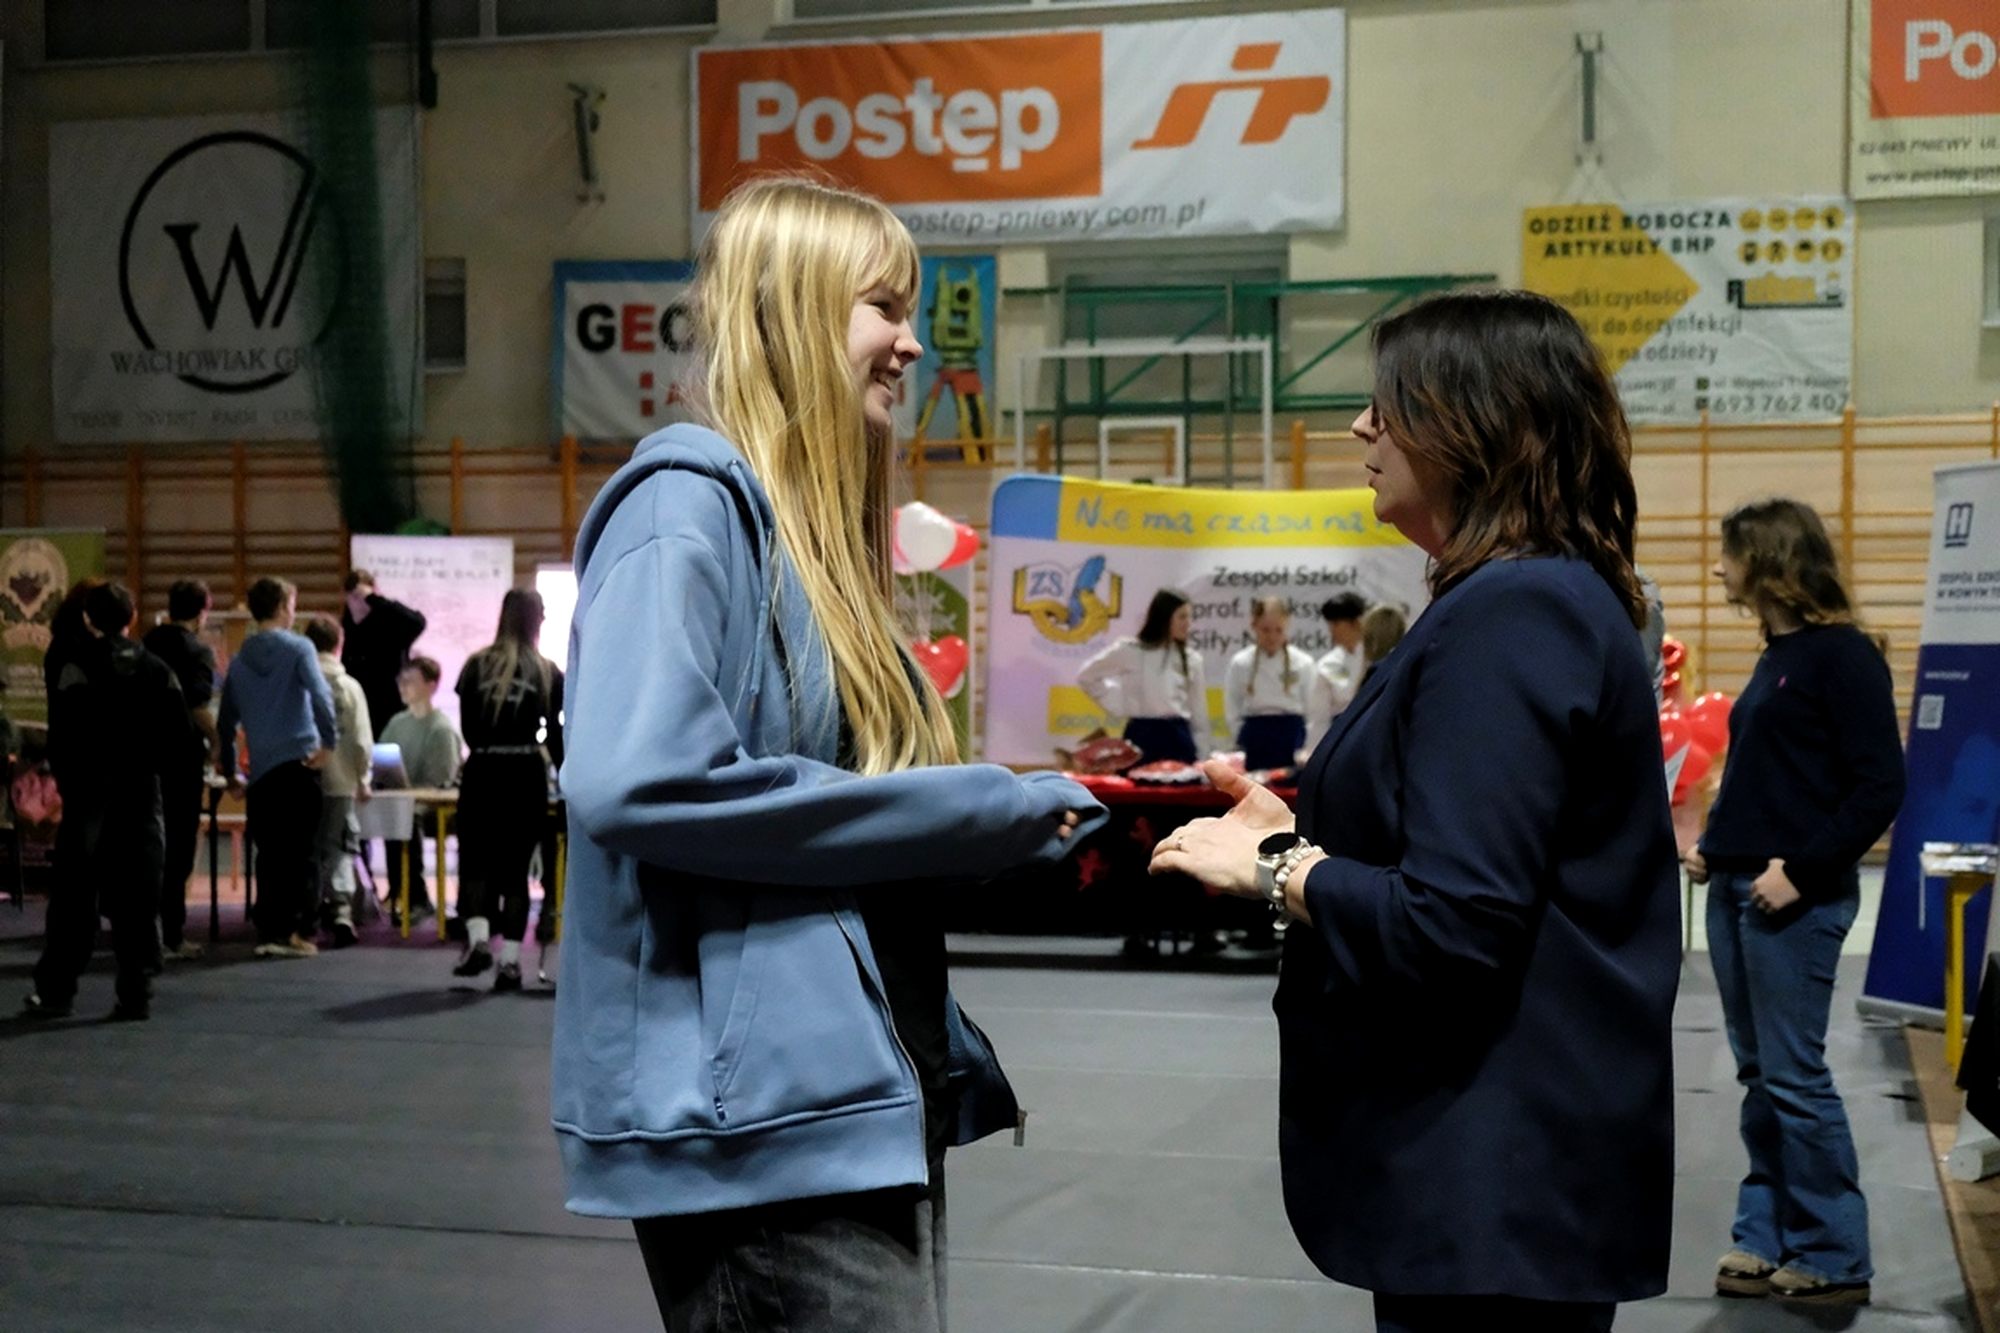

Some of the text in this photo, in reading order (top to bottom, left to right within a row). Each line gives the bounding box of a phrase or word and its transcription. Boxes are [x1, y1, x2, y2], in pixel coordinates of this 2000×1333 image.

[1905, 18, 2000, 83] Po
[737, 76, 1060, 173] Postęp
[902, 197, 1206, 236] ostep-pniewy.com.pl
[1530, 207, 1732, 236] ODZIEŻ ROBOCZA
[1543, 236, 1716, 259] ARTYKUŁY BHP
[110, 346, 267, 376] WACHOWIAK
[1028, 571, 1064, 597] ZS
[1213, 565, 1359, 589] Zespół Szkół
[1192, 597, 1244, 621] prof.
